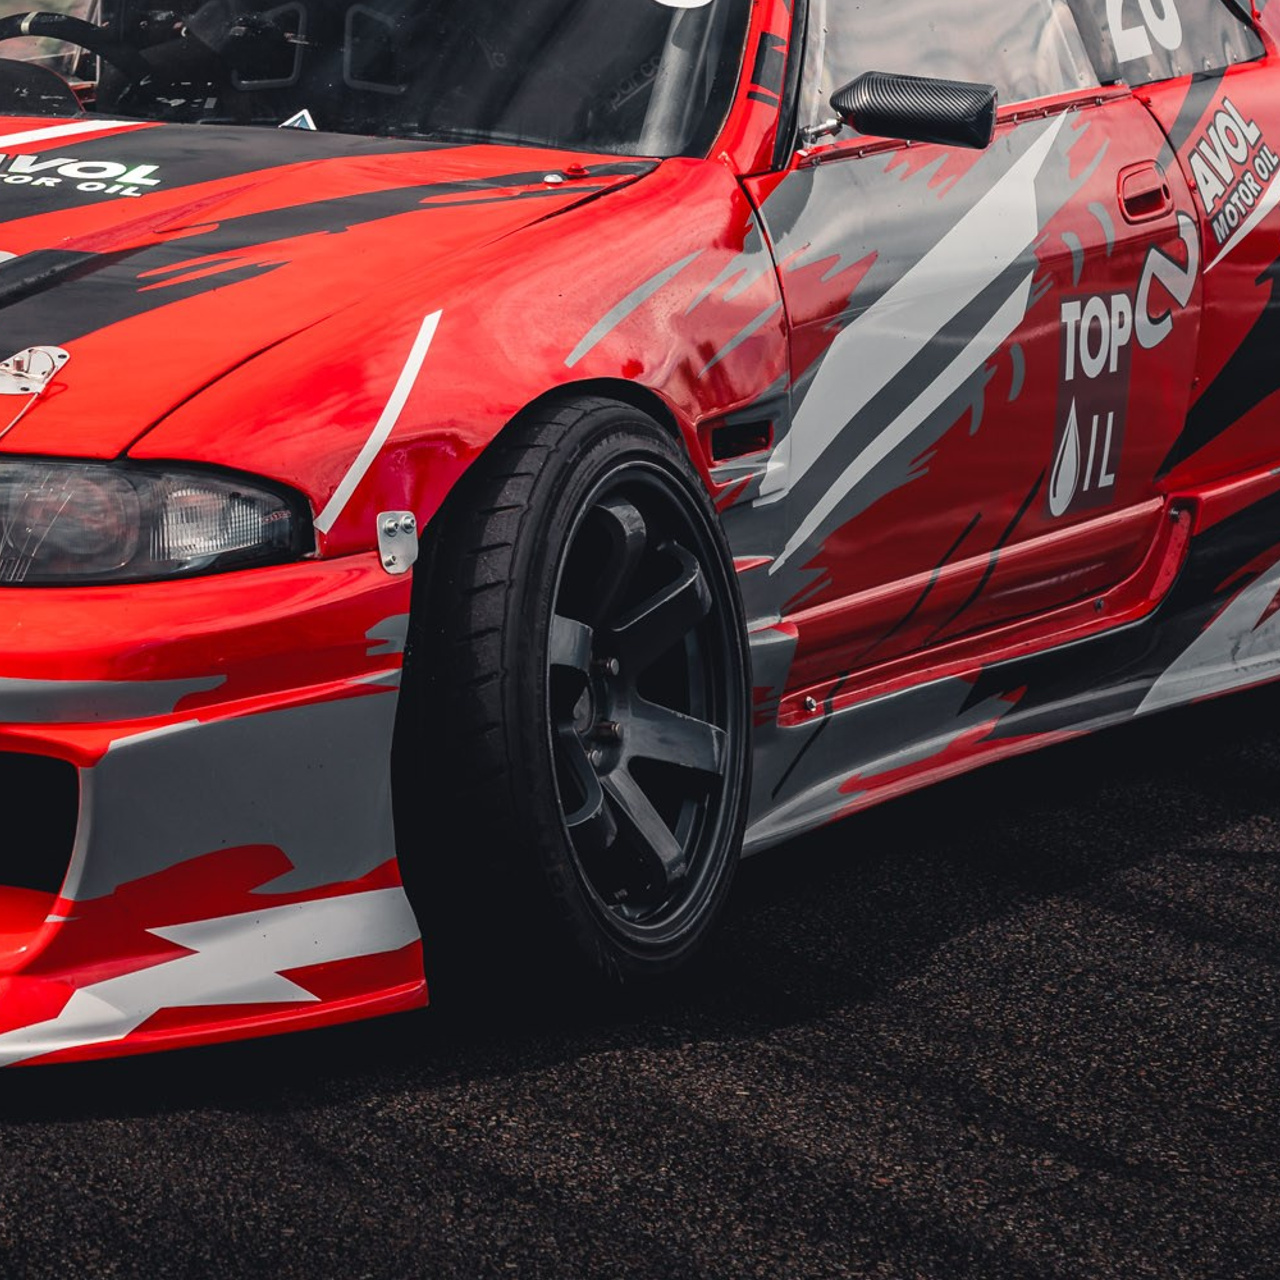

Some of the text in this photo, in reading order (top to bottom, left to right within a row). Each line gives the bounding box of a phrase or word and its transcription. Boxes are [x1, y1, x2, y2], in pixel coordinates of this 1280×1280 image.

[75, 181, 142, 197] OIL
[1189, 97, 1262, 215] AVOL
[1211, 143, 1279, 244] MOTOR OIL
[1061, 293, 1133, 381] TOP
